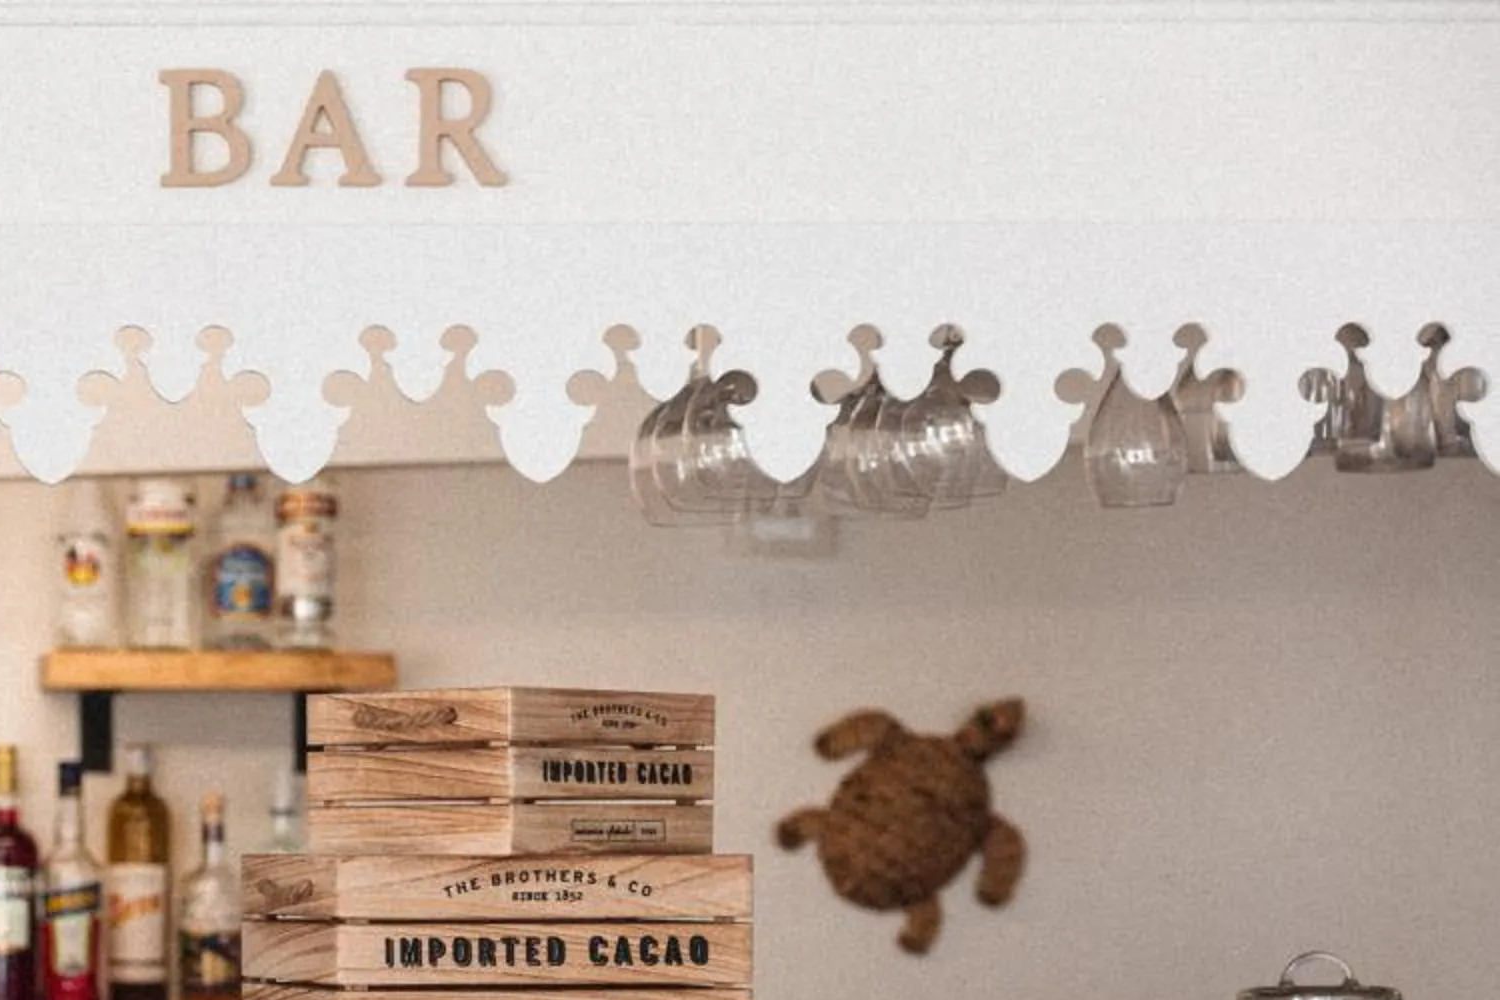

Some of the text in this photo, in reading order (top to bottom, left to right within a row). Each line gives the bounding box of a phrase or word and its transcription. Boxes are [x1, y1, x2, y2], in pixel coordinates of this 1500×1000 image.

[158, 68, 508, 188] BAR
[543, 760, 693, 786] IMPORTED CACAO
[443, 868, 653, 899] THE BROTHERS & CO
[384, 935, 710, 969] IMPORTED CACAO
